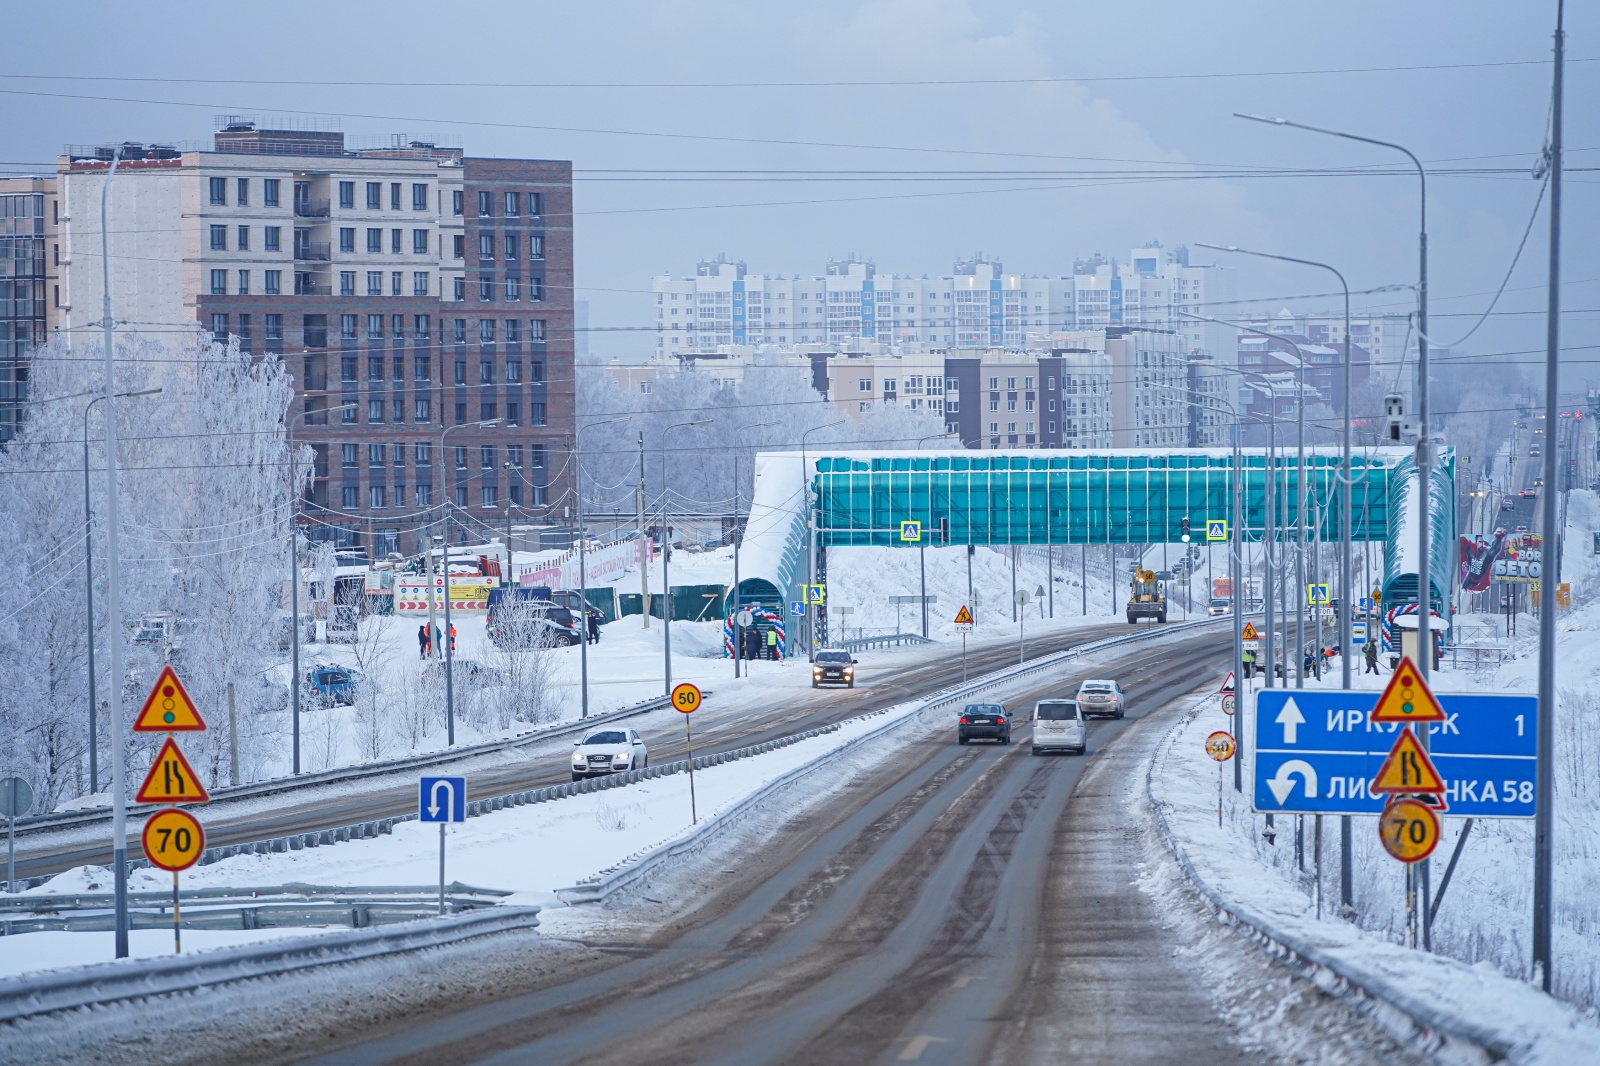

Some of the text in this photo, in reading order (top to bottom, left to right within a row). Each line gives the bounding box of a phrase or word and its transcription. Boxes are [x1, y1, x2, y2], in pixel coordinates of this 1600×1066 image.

[679, 692, 695, 704] 50
[1326, 709, 1524, 736] ИРКК 1
[1326, 776, 1534, 803] ЛИСНКА 58
[156, 827, 192, 853] 70
[1392, 818, 1426, 844] 70
